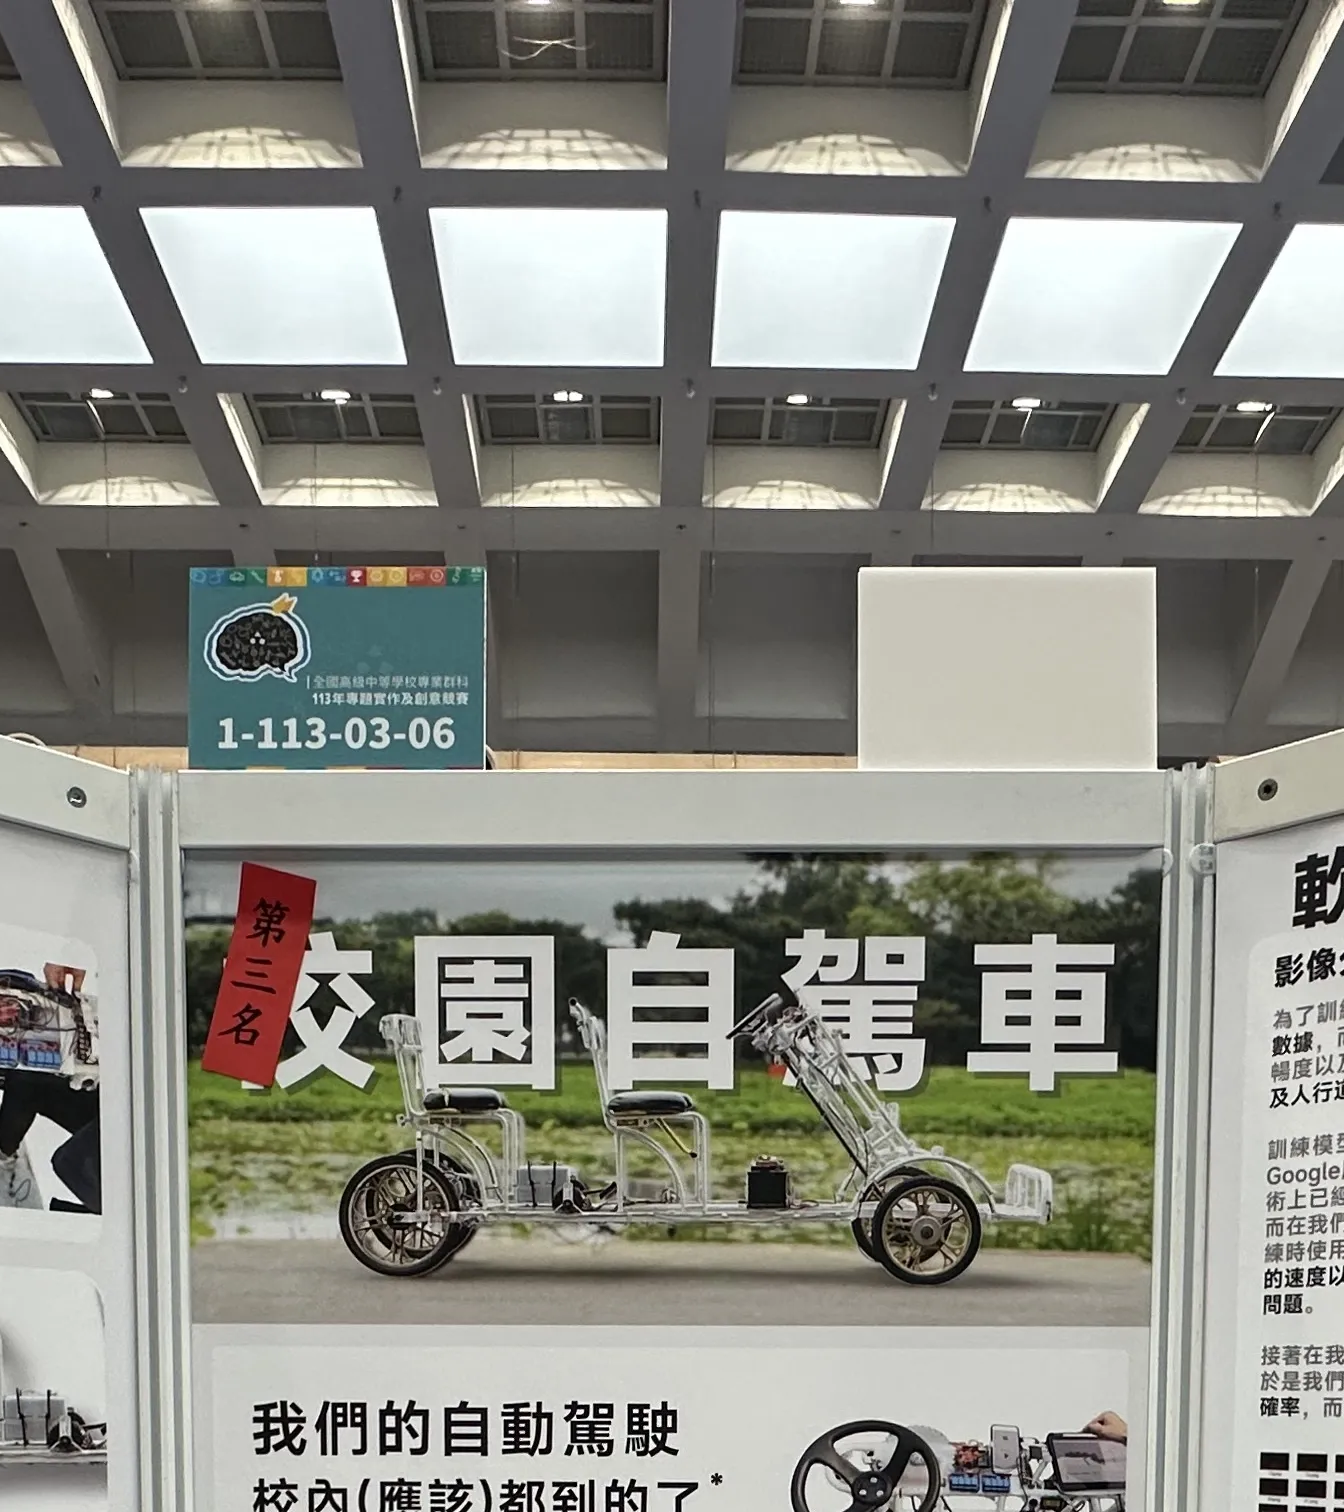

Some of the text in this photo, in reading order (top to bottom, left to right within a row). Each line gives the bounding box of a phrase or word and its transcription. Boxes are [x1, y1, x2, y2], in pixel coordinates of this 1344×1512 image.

[218, 717, 455, 749] 1-113-03-06
[218, 896, 287, 1049] 第三名
[226, 929, 1118, 1092] 校園自駕車
[1262, 1293, 1314, 1315] 問題。
[252, 1400, 680, 1457] 我們的自動駕駛
